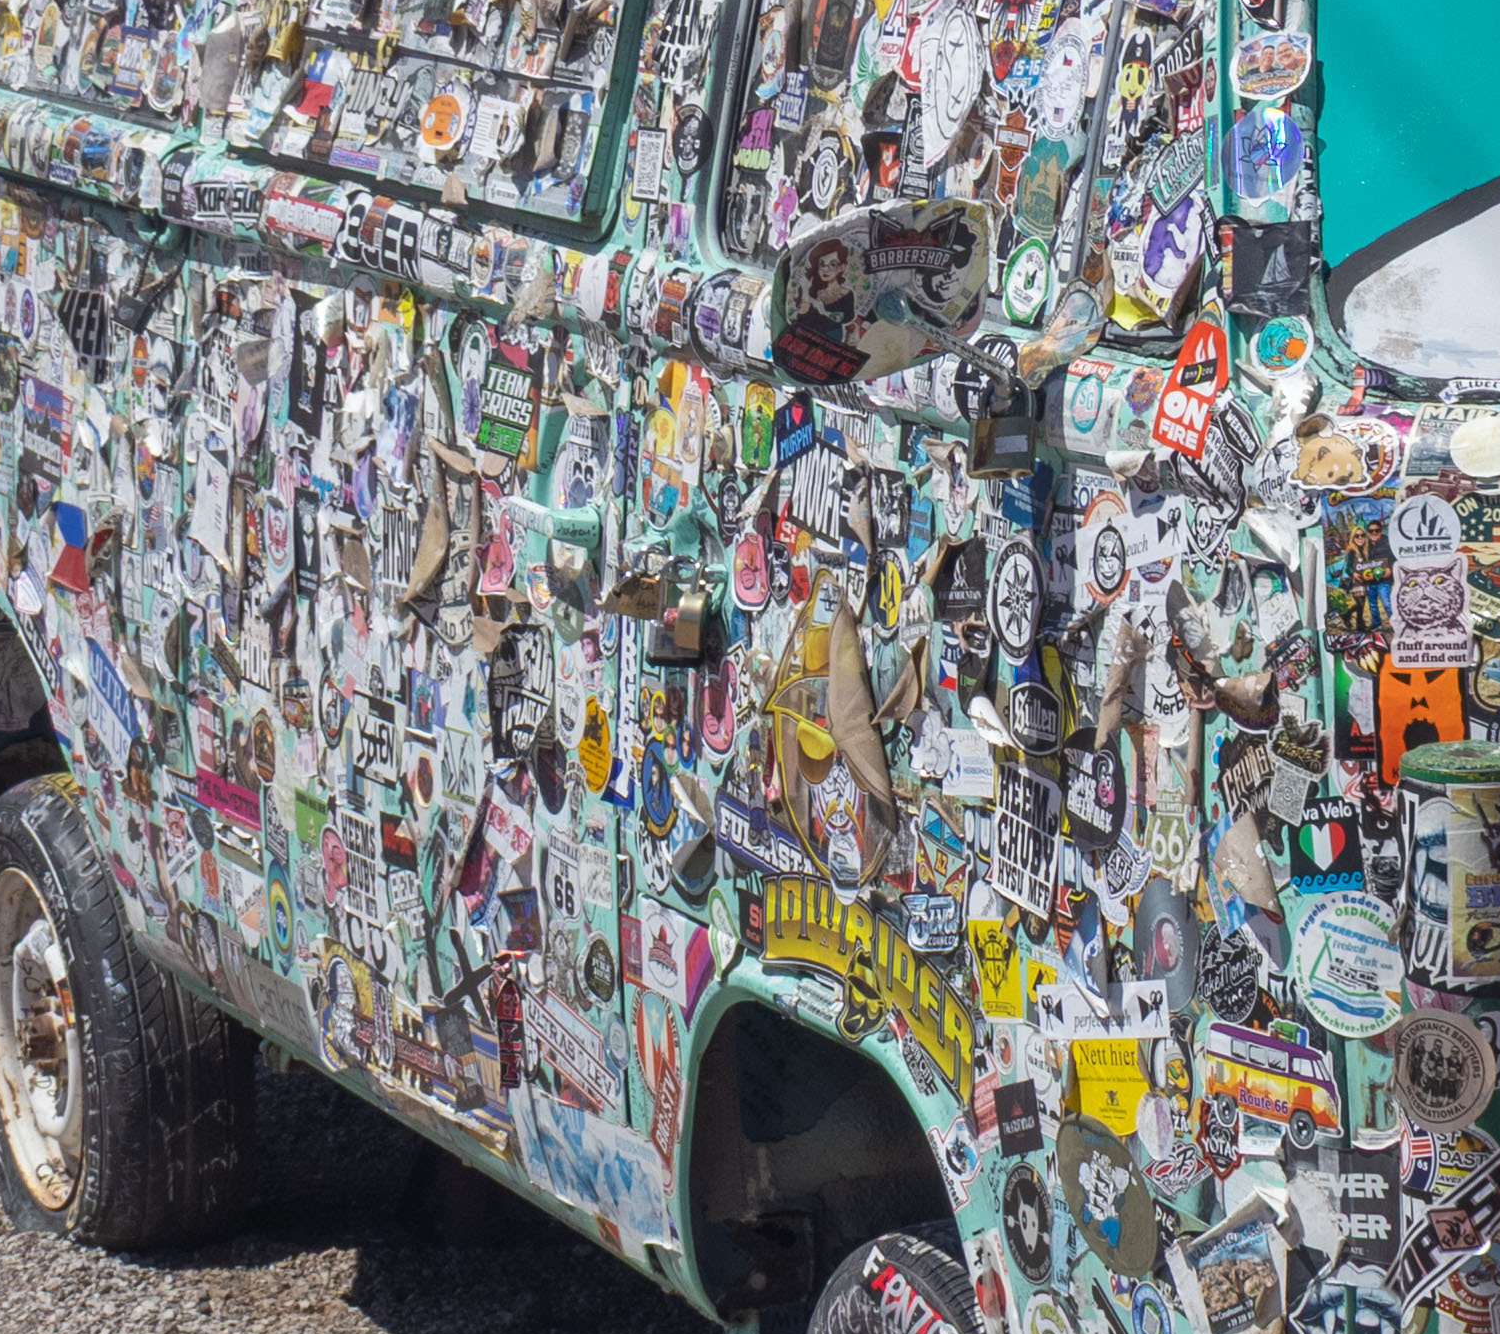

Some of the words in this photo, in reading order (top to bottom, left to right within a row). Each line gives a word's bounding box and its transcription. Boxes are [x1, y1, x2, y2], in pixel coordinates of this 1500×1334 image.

[869, 251, 950, 269] BARBERSHOP
[487, 369, 529, 399] TEAM
[481, 393, 532, 425] CROSS
[1163, 390, 1209, 432] ON
[779, 422, 815, 455] MURPHY
[1158, 417, 1199, 452] FIRE
[1457, 499, 1479, 519] ON
[1396, 640, 1423, 651] fluff
[1424, 640, 1468, 651] around
[1398, 654, 1419, 663] and
[1421, 653, 1445, 663] find
[1447, 653, 1467, 663] out
[1322, 802, 1353, 819] Velo
[1150, 820, 1184, 864] 66
[553, 886, 576, 916] 66
[1342, 895, 1381, 912] Baden
[1334, 907, 1390, 934] OEDHEIM
[764, 874, 974, 1105] LOWRIDER
[1079, 1045, 1105, 1065] Nett
[1238, 1087, 1272, 1110] Route
[1274, 1098, 1290, 1115] 66
